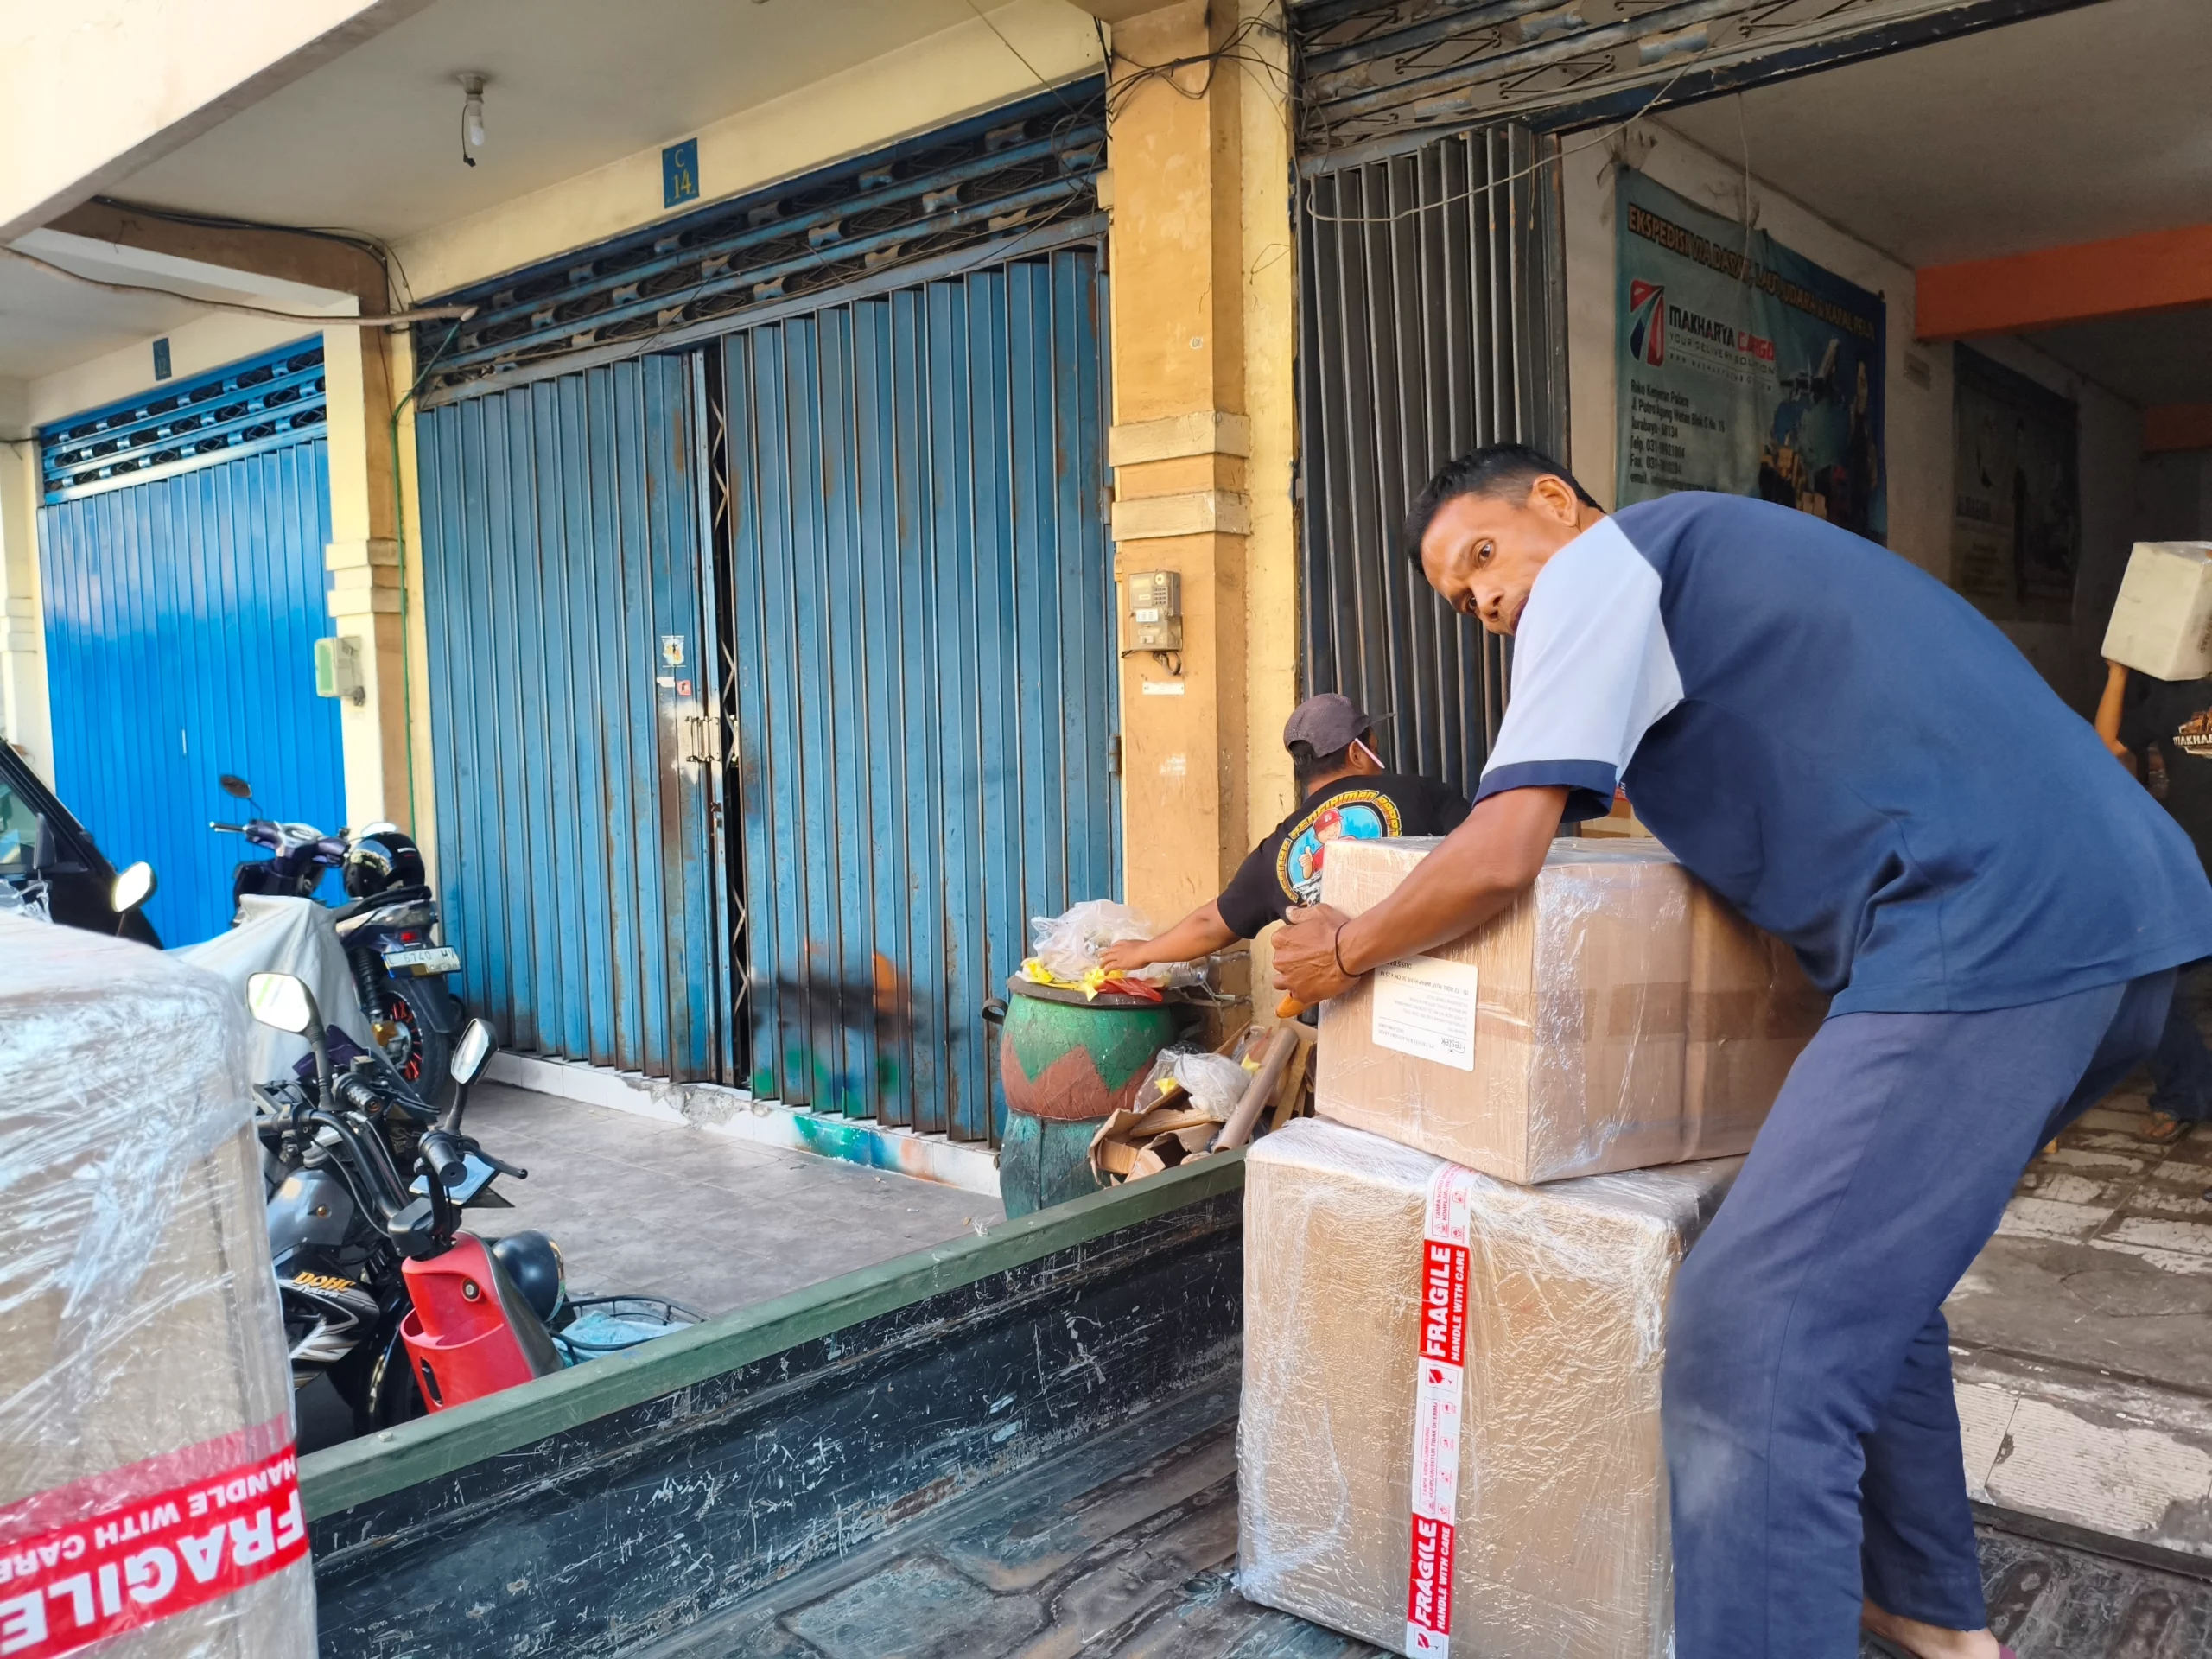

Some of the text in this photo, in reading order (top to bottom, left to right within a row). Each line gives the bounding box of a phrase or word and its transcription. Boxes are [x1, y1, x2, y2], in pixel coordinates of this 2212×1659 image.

[674, 168, 691, 200] 14
[675, 149, 685, 168] C
[1628, 201, 1691, 258] EKSPEDISI
[1669, 304, 1735, 348] MAKHARYA
[1400, 961, 1411, 969] DUS
[293, 1271, 356, 1294] DOHC
[1427, 1245, 1451, 1357] FRAGILE
[1451, 1249, 1465, 1362] HANDLE WITH CARE
[186, 1452, 296, 1518] HANDLE
[94, 1502, 181, 1549] WITH
[0, 1488, 305, 1656] FRAGILE
[1415, 1519, 1436, 1627] FRAGILE
[1437, 1526, 1451, 1630] HANDLE WITH CARE
